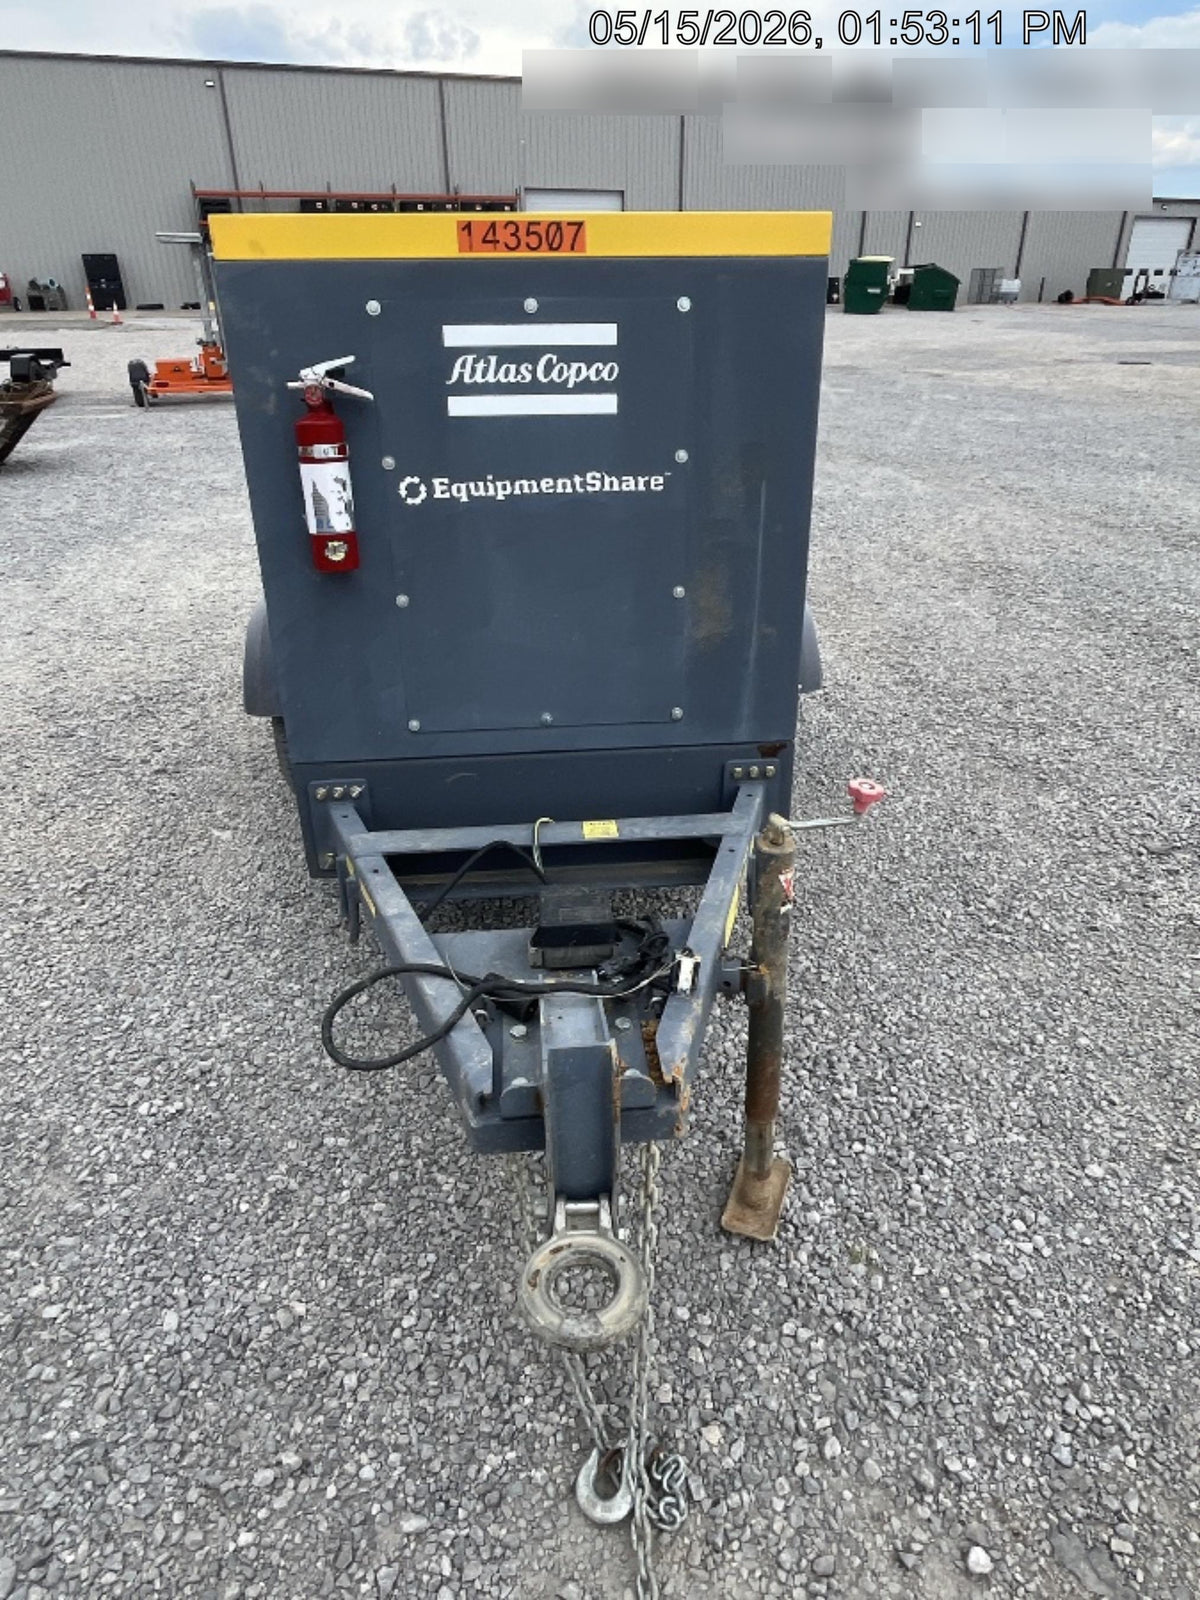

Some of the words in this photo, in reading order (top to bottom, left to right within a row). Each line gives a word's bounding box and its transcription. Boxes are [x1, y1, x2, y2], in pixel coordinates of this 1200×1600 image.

[460, 220, 584, 251] 143507
[446, 353, 533, 385] Atlas
[536, 353, 620, 389] Copco
[431, 471, 665, 502] EquipmentShare
